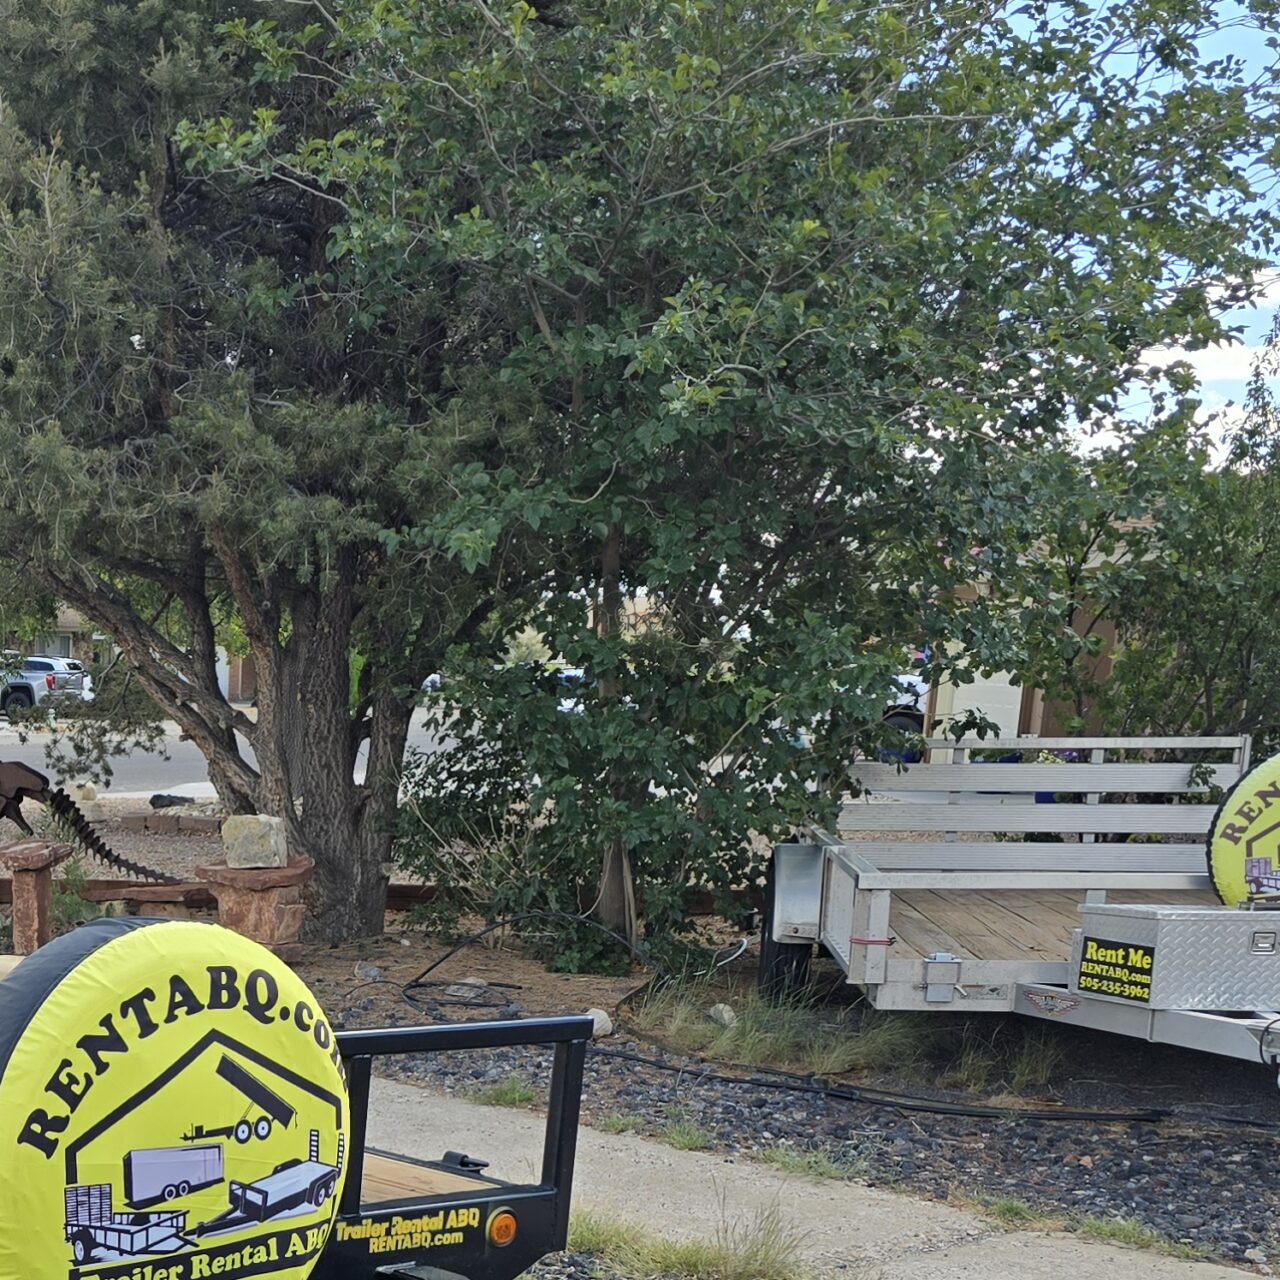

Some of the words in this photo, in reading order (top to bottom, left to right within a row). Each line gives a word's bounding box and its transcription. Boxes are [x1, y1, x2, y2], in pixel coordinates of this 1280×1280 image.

[1086, 940, 1125, 965] Rent
[1127, 947, 1152, 969] Me
[1081, 961, 1151, 984] RENTABQ.com
[1080, 976, 1149, 999] 505-235-3962
[335, 1218, 389, 1242] Trailer
[391, 1211, 444, 1235] Rental
[446, 1207, 480, 1229] ABQ
[190, 1237, 279, 1280] Rental
[284, 1223, 329, 1257] ABQ
[369, 1231, 463, 1254] RENTABQ.com
